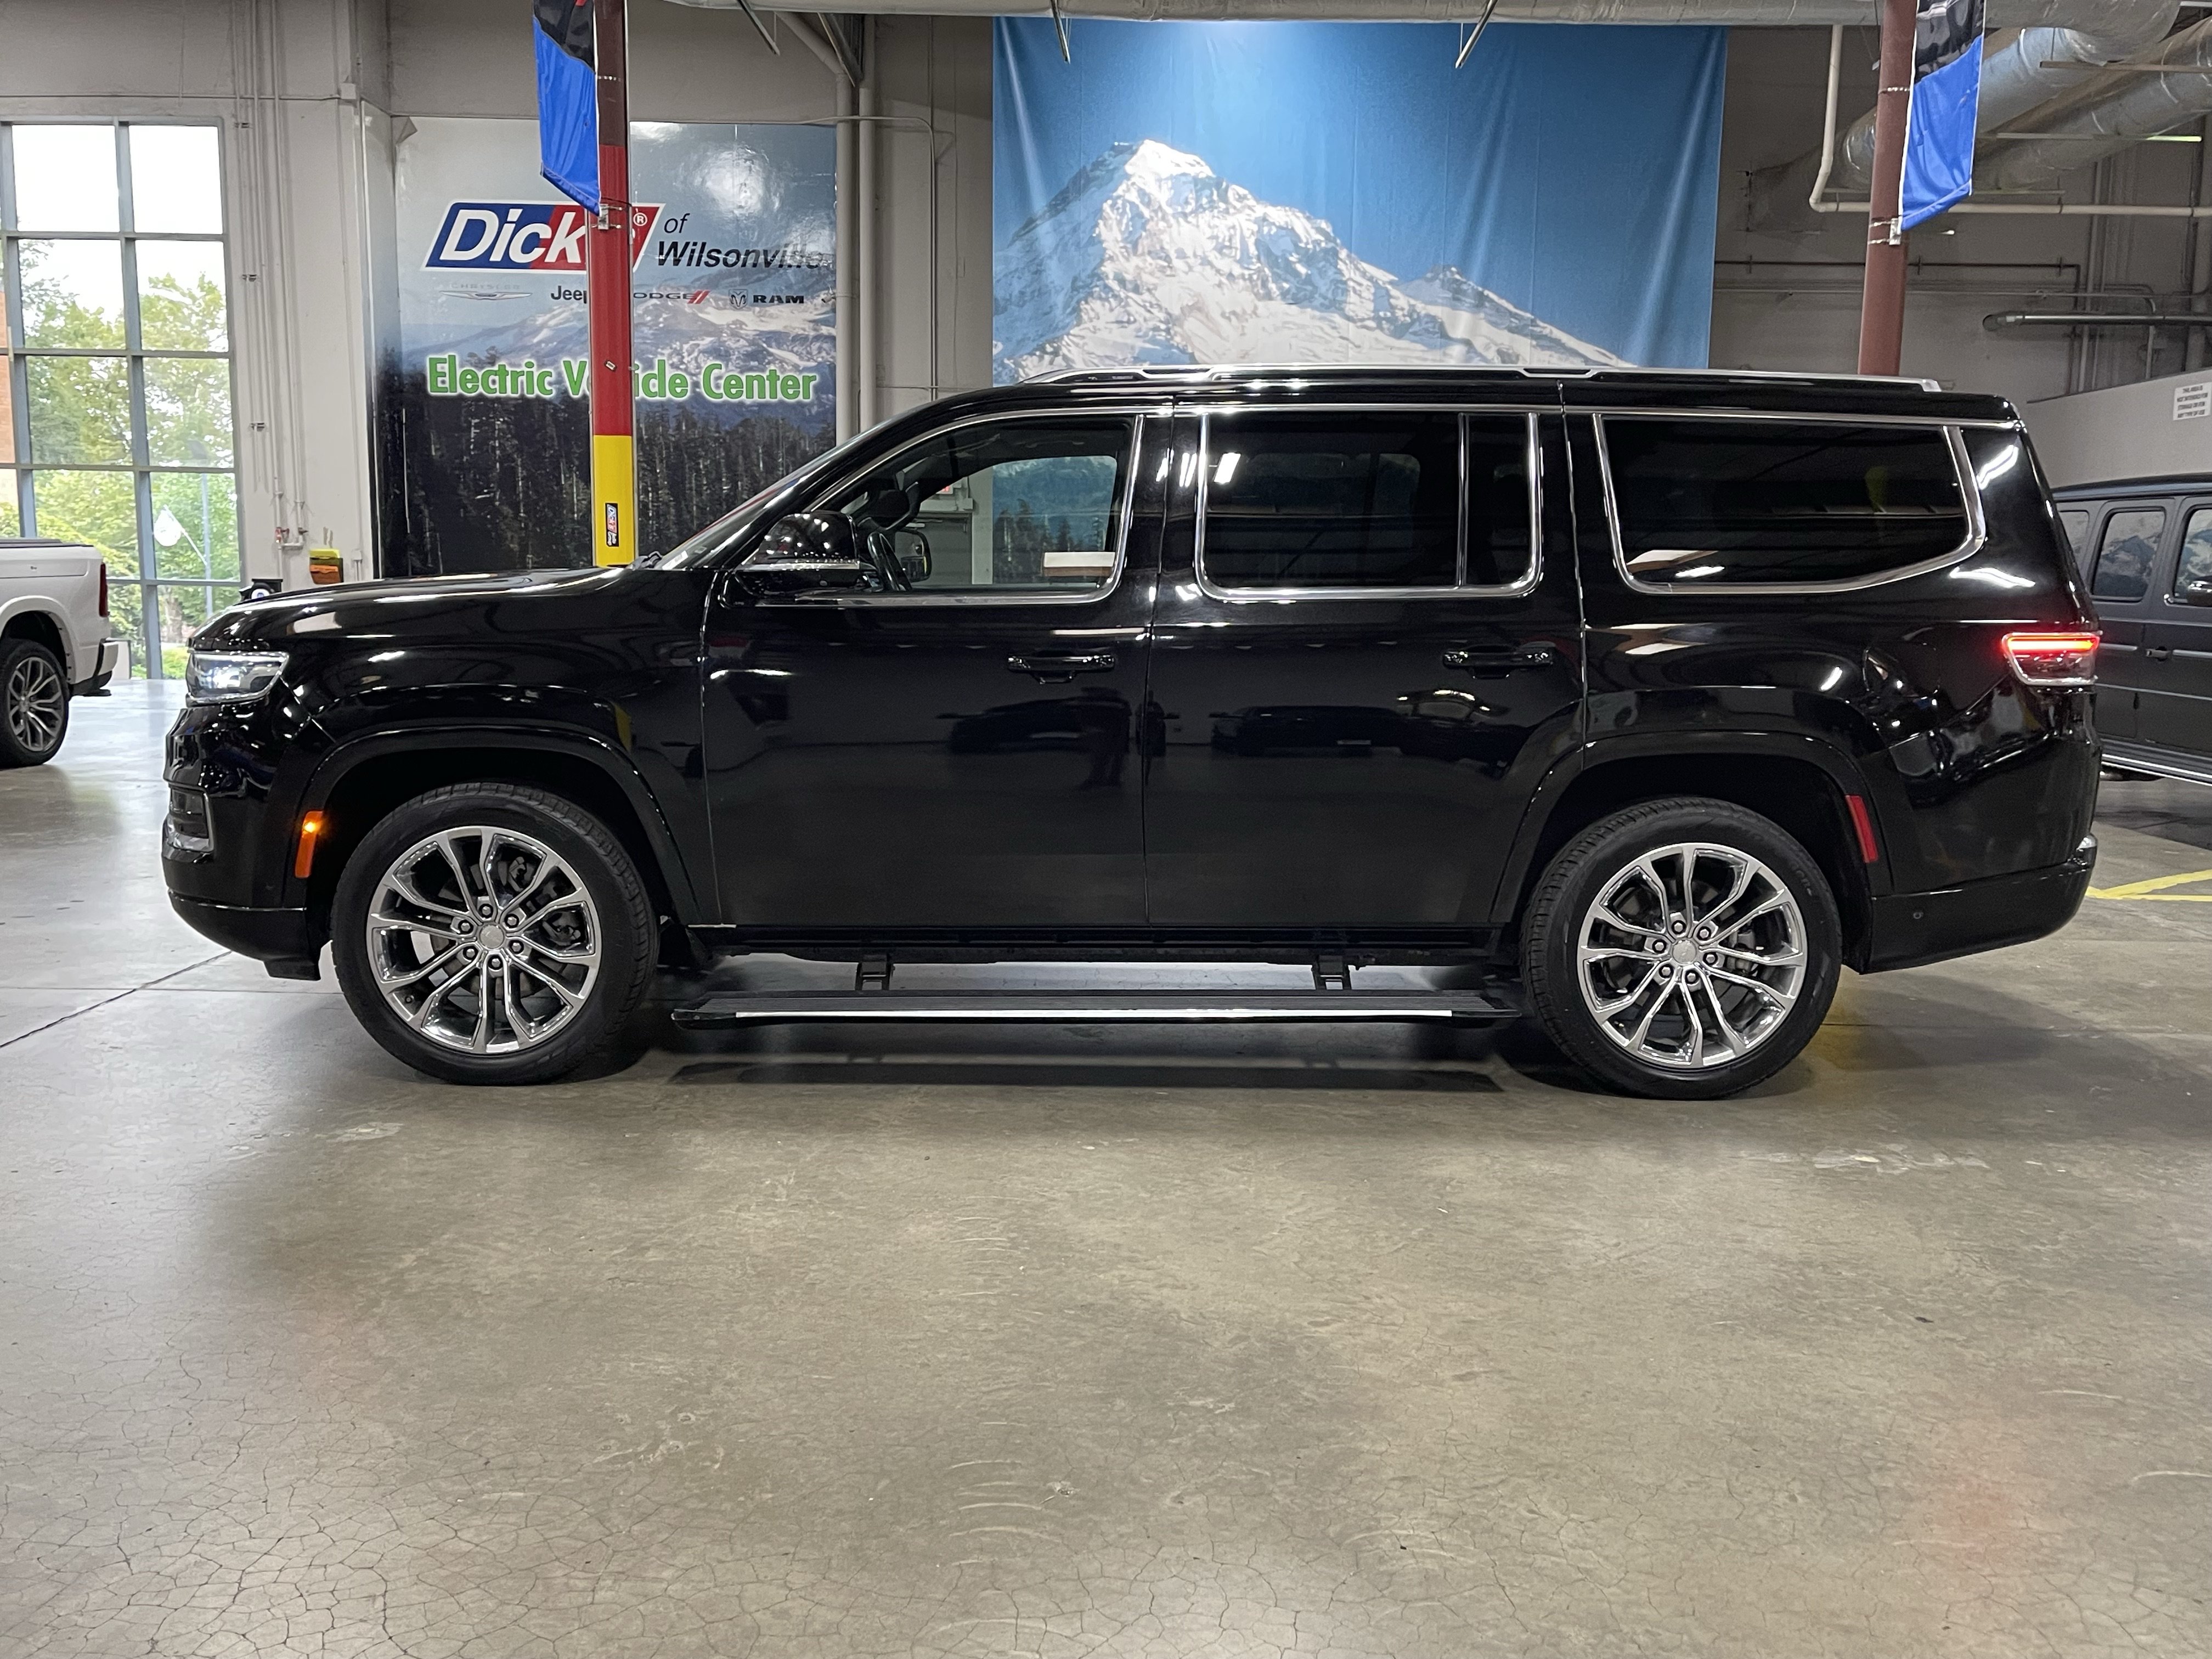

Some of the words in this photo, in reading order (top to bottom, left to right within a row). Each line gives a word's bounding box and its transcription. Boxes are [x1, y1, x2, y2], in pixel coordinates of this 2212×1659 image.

[664, 213, 690, 234] of
[439, 208, 586, 263] Dick
[633, 292, 696, 300] ODGE
[753, 295, 804, 304] RAM
[428, 354, 553, 396] Electric
[562, 359, 689, 398] Vicle
[703, 363, 817, 400] Center
